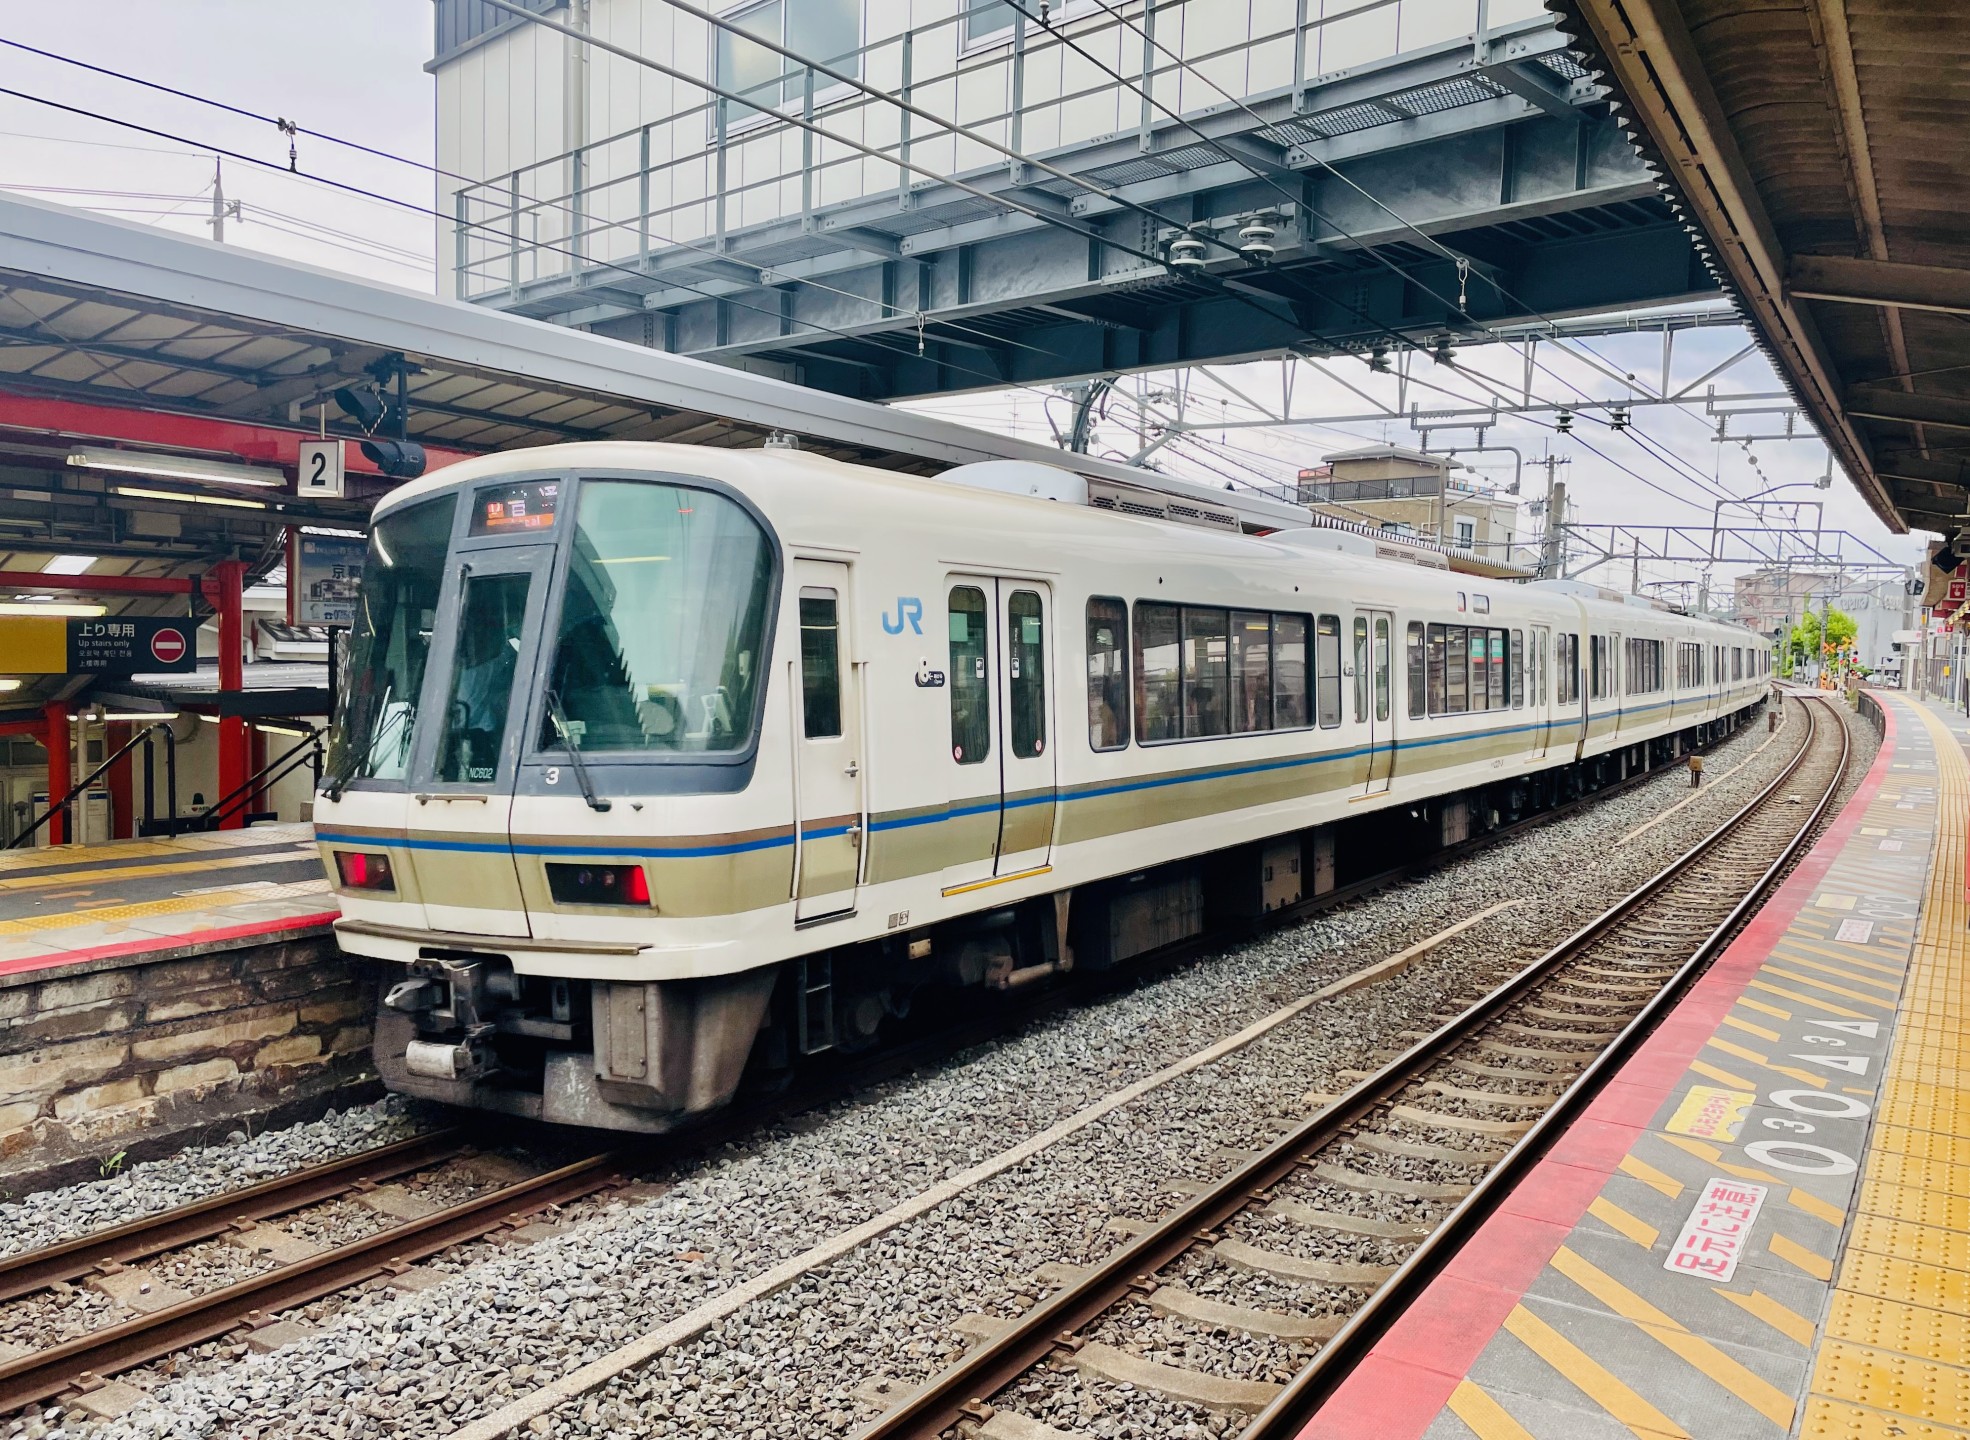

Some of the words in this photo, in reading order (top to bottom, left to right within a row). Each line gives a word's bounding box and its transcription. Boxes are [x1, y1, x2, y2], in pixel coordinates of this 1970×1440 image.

[310, 452, 327, 487] 2
[881, 596, 923, 635] JR
[78, 622, 135, 638] 上り専用
[78, 639, 90, 648] Up
[113, 639, 130, 648] only
[545, 767, 560, 785] 3
